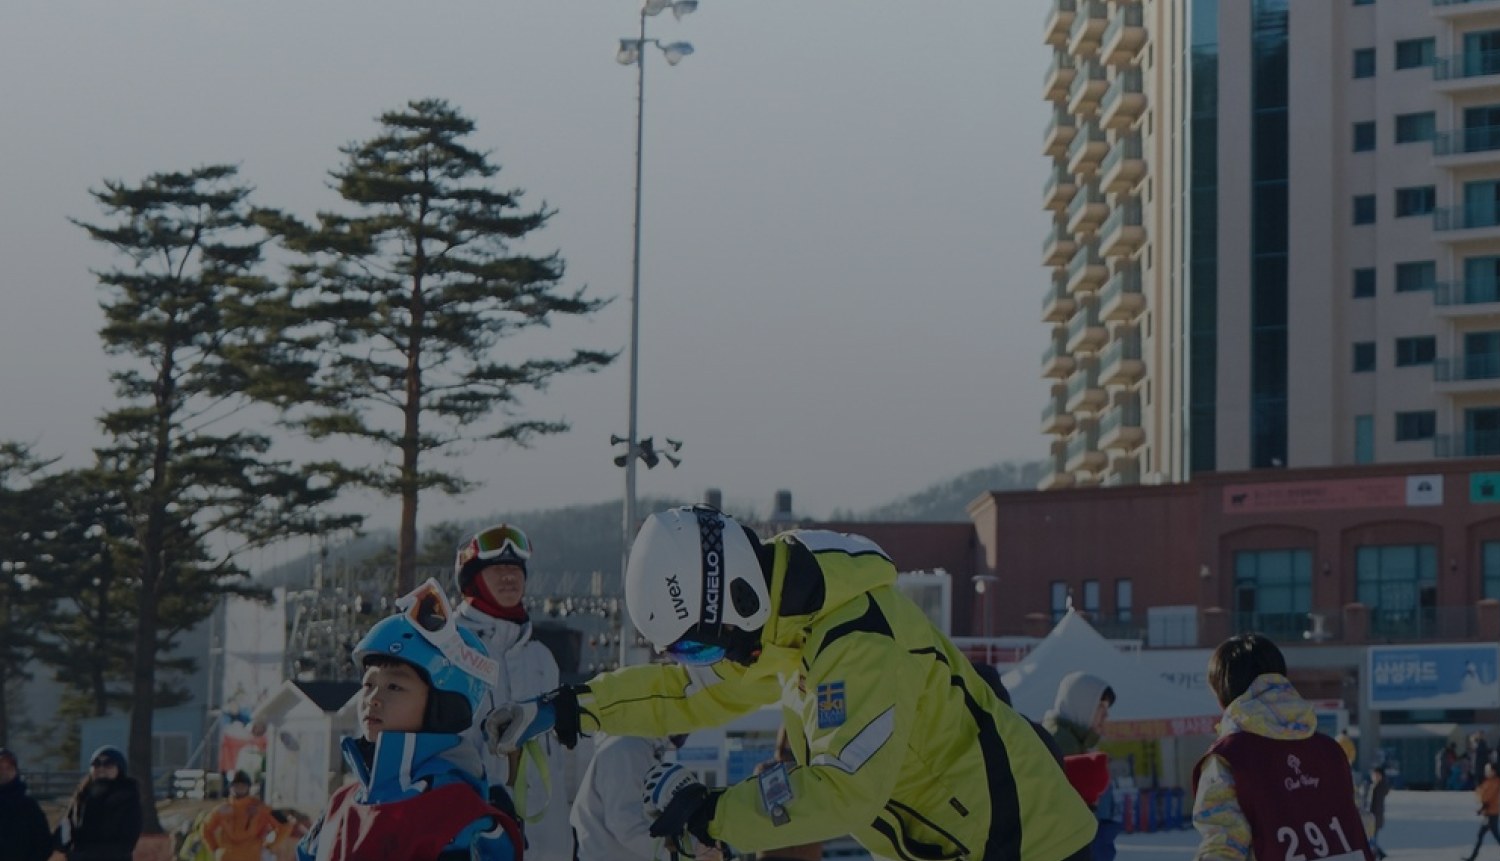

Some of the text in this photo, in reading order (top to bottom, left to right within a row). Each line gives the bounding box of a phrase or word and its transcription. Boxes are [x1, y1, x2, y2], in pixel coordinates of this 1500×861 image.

[665, 574, 689, 620] uvex
[1375, 660, 1439, 685] 삼성카드
[1276, 815, 1352, 861] 291
